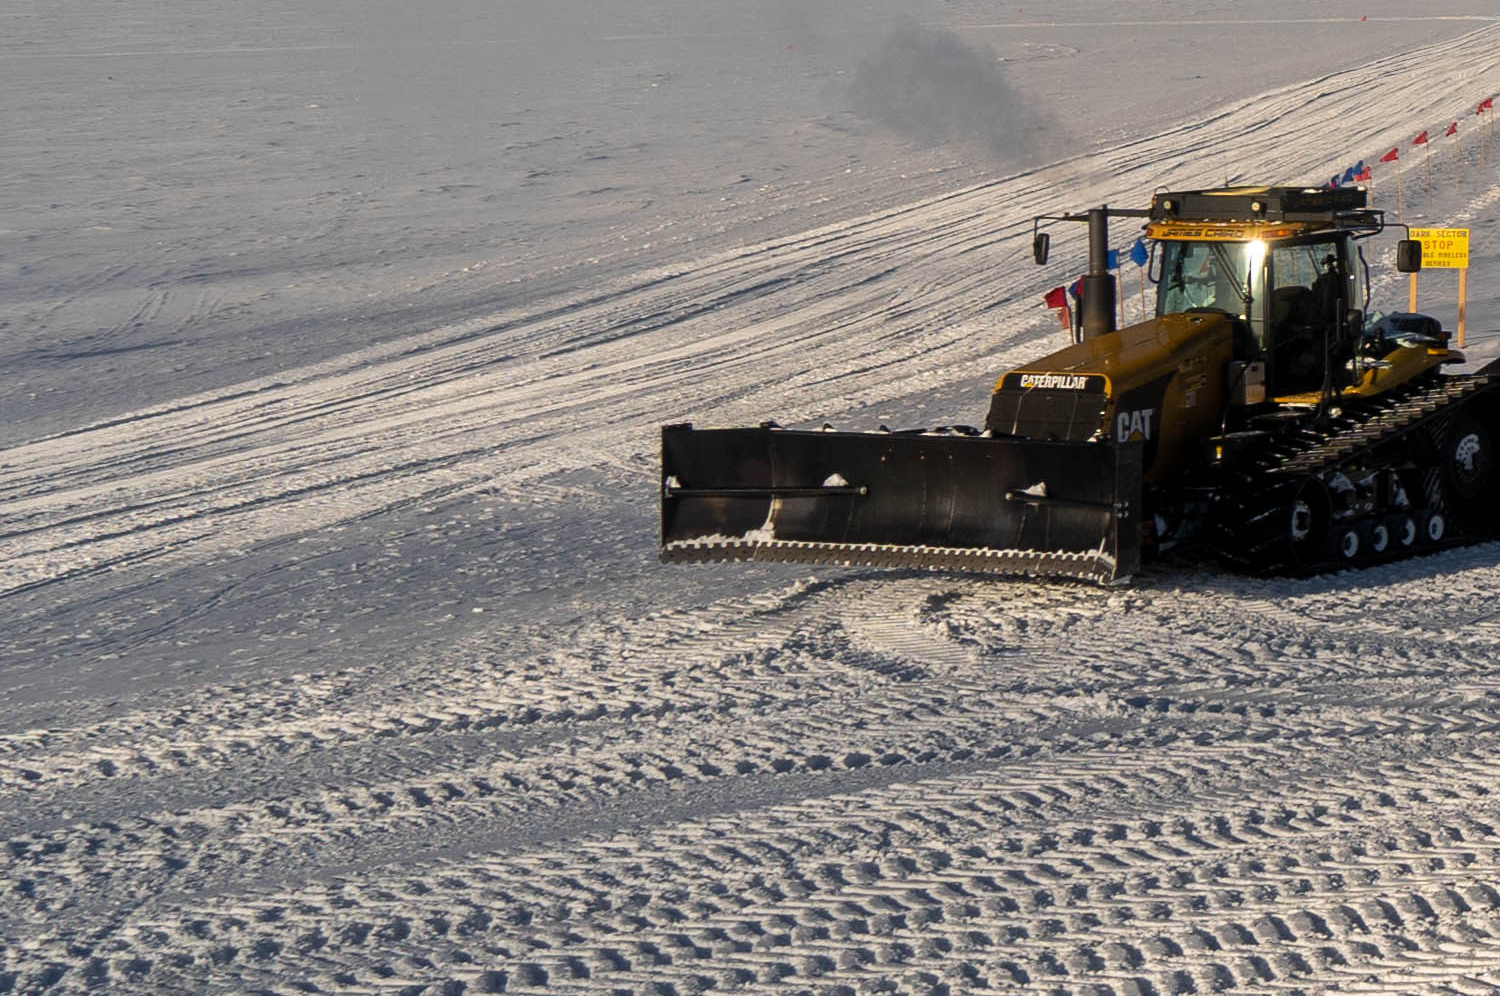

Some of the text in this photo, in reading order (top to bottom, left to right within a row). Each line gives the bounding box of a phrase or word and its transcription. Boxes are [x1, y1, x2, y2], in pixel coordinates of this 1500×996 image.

[1162, 228, 1202, 237] JAMES
[1436, 230, 1467, 238] SECTOR
[1424, 240, 1453, 250] STOP
[1020, 374, 1087, 390] CATERPILLAR
[1117, 408, 1153, 444] CAT
